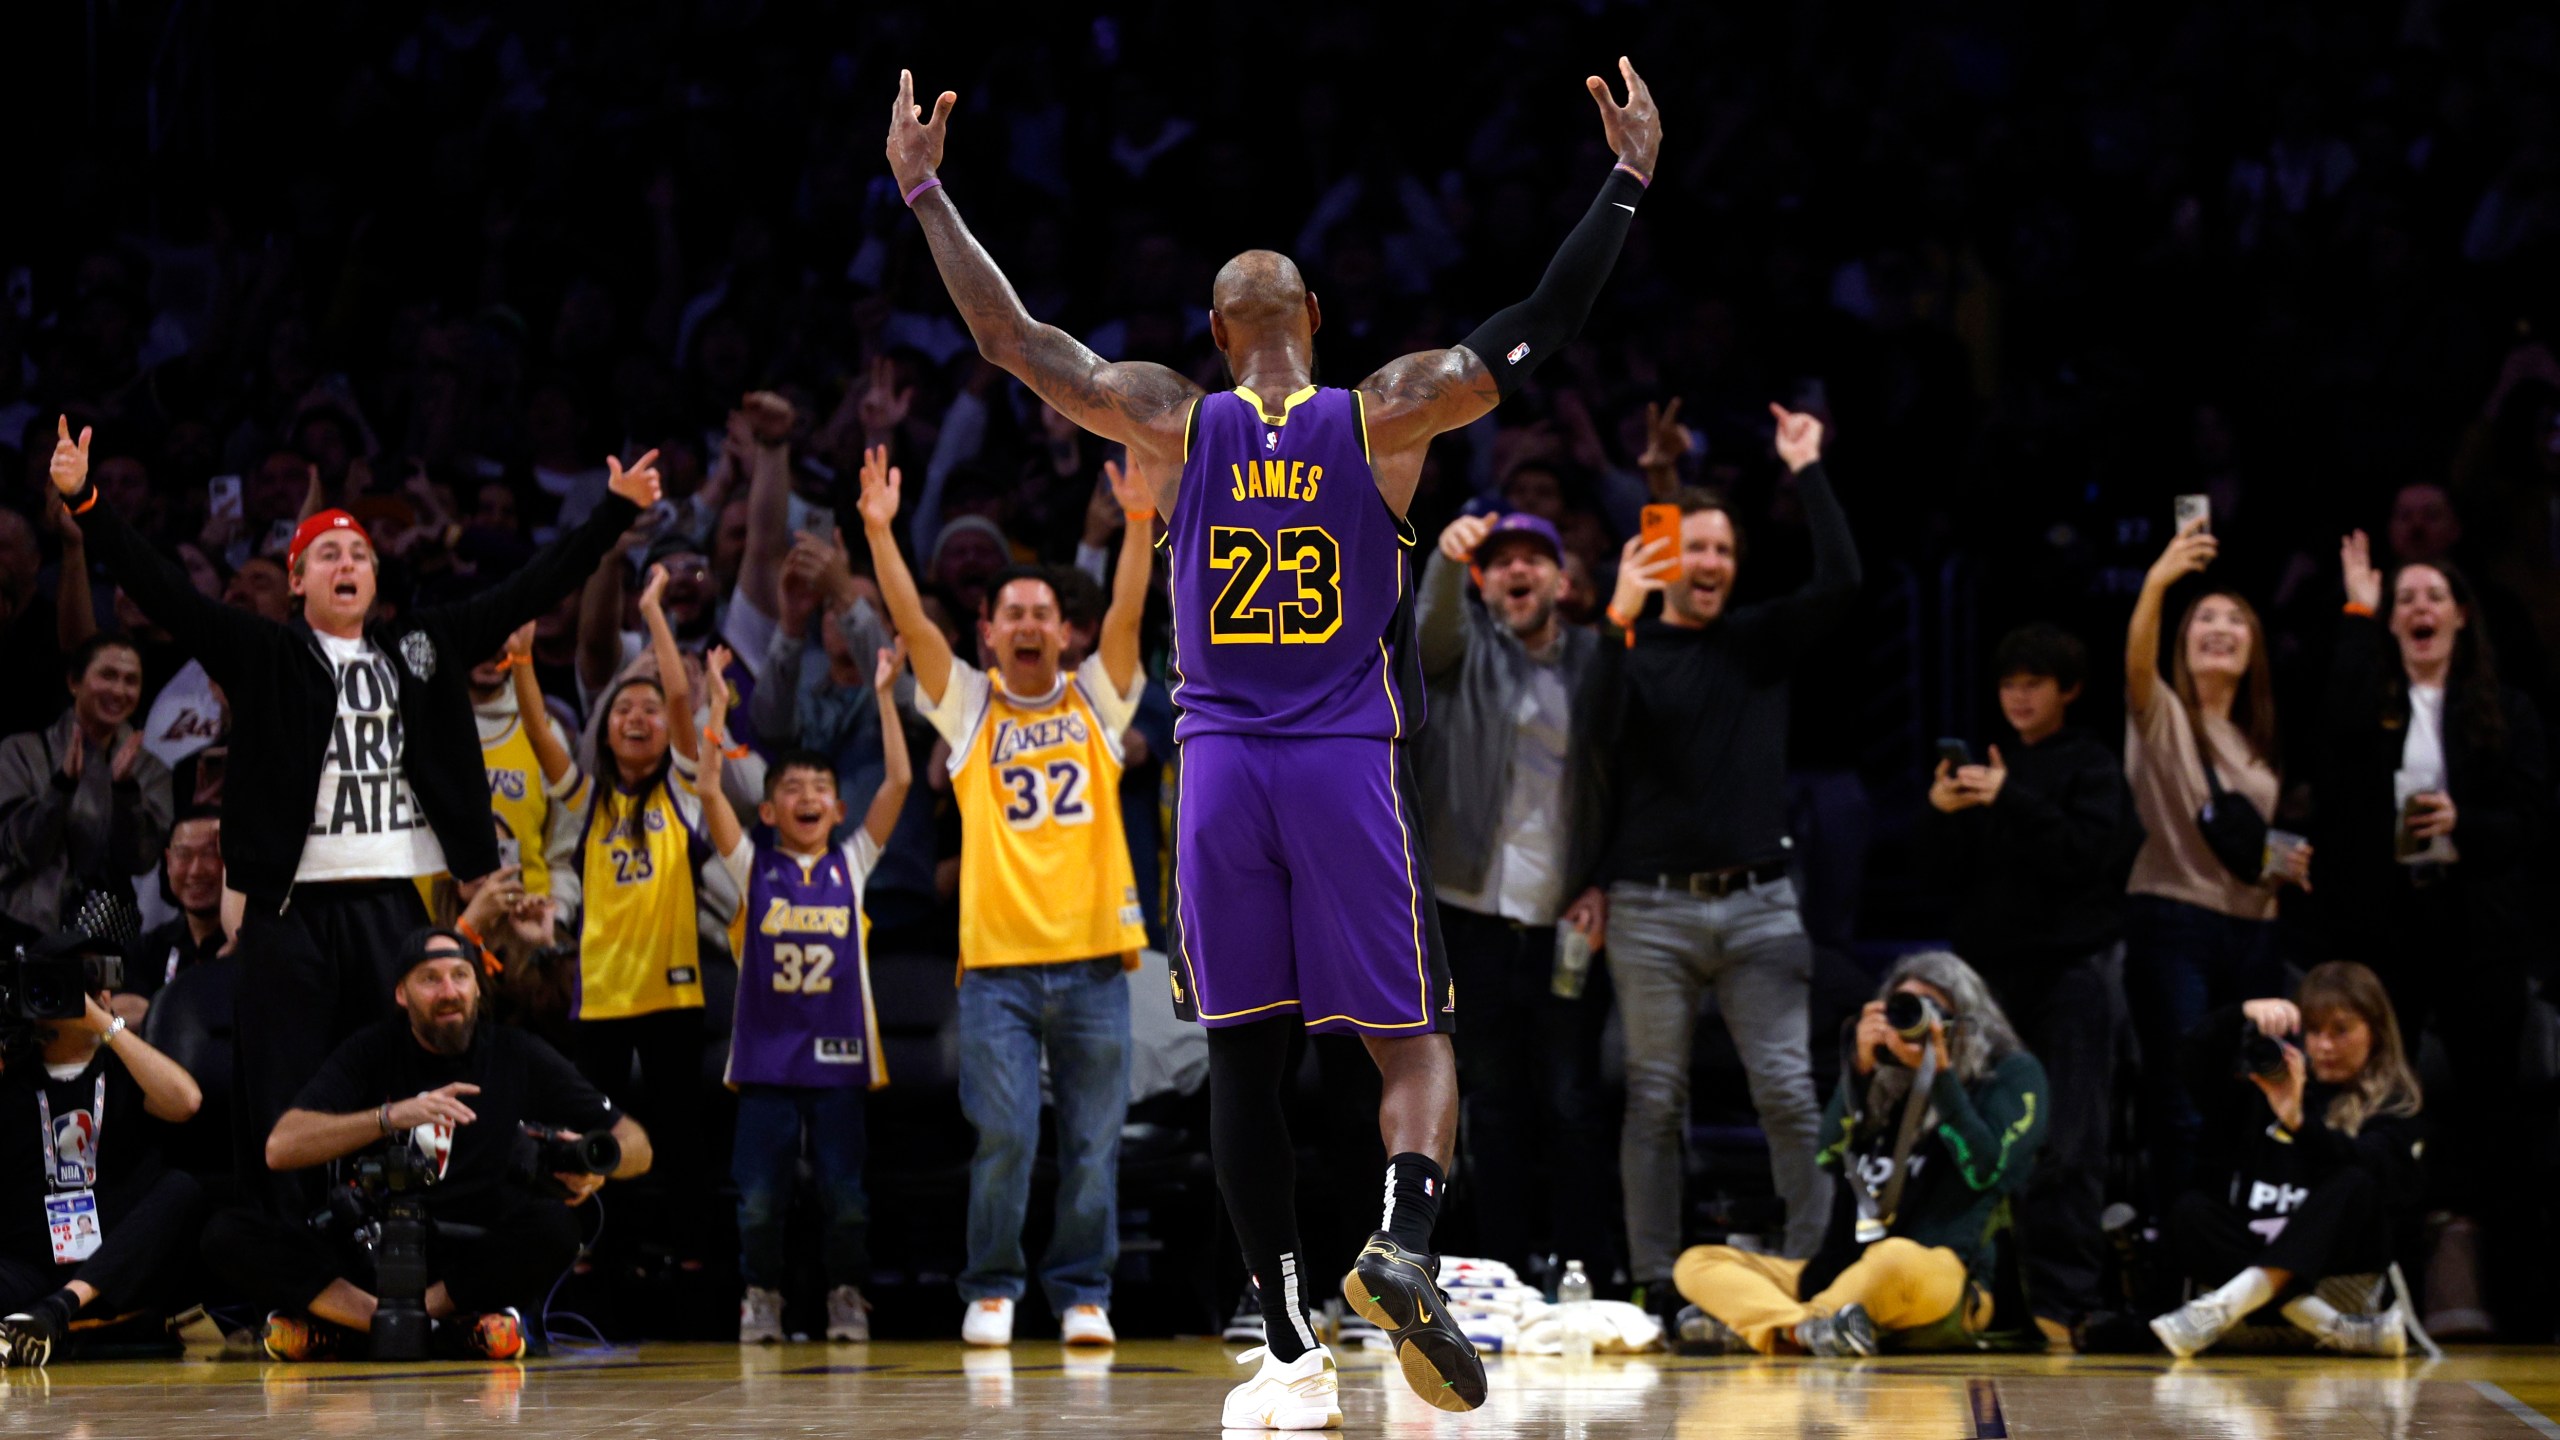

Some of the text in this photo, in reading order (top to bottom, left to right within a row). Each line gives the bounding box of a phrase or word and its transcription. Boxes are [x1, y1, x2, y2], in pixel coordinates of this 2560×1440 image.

[1231, 459, 1324, 502] JAMES
[1209, 525, 1343, 645] 23
[988, 712, 1088, 765] LAKERS
[1002, 759, 1094, 829] 32
[610, 848, 655, 885] 23
[759, 896, 851, 939] LAKERS
[772, 941, 836, 995] 32
